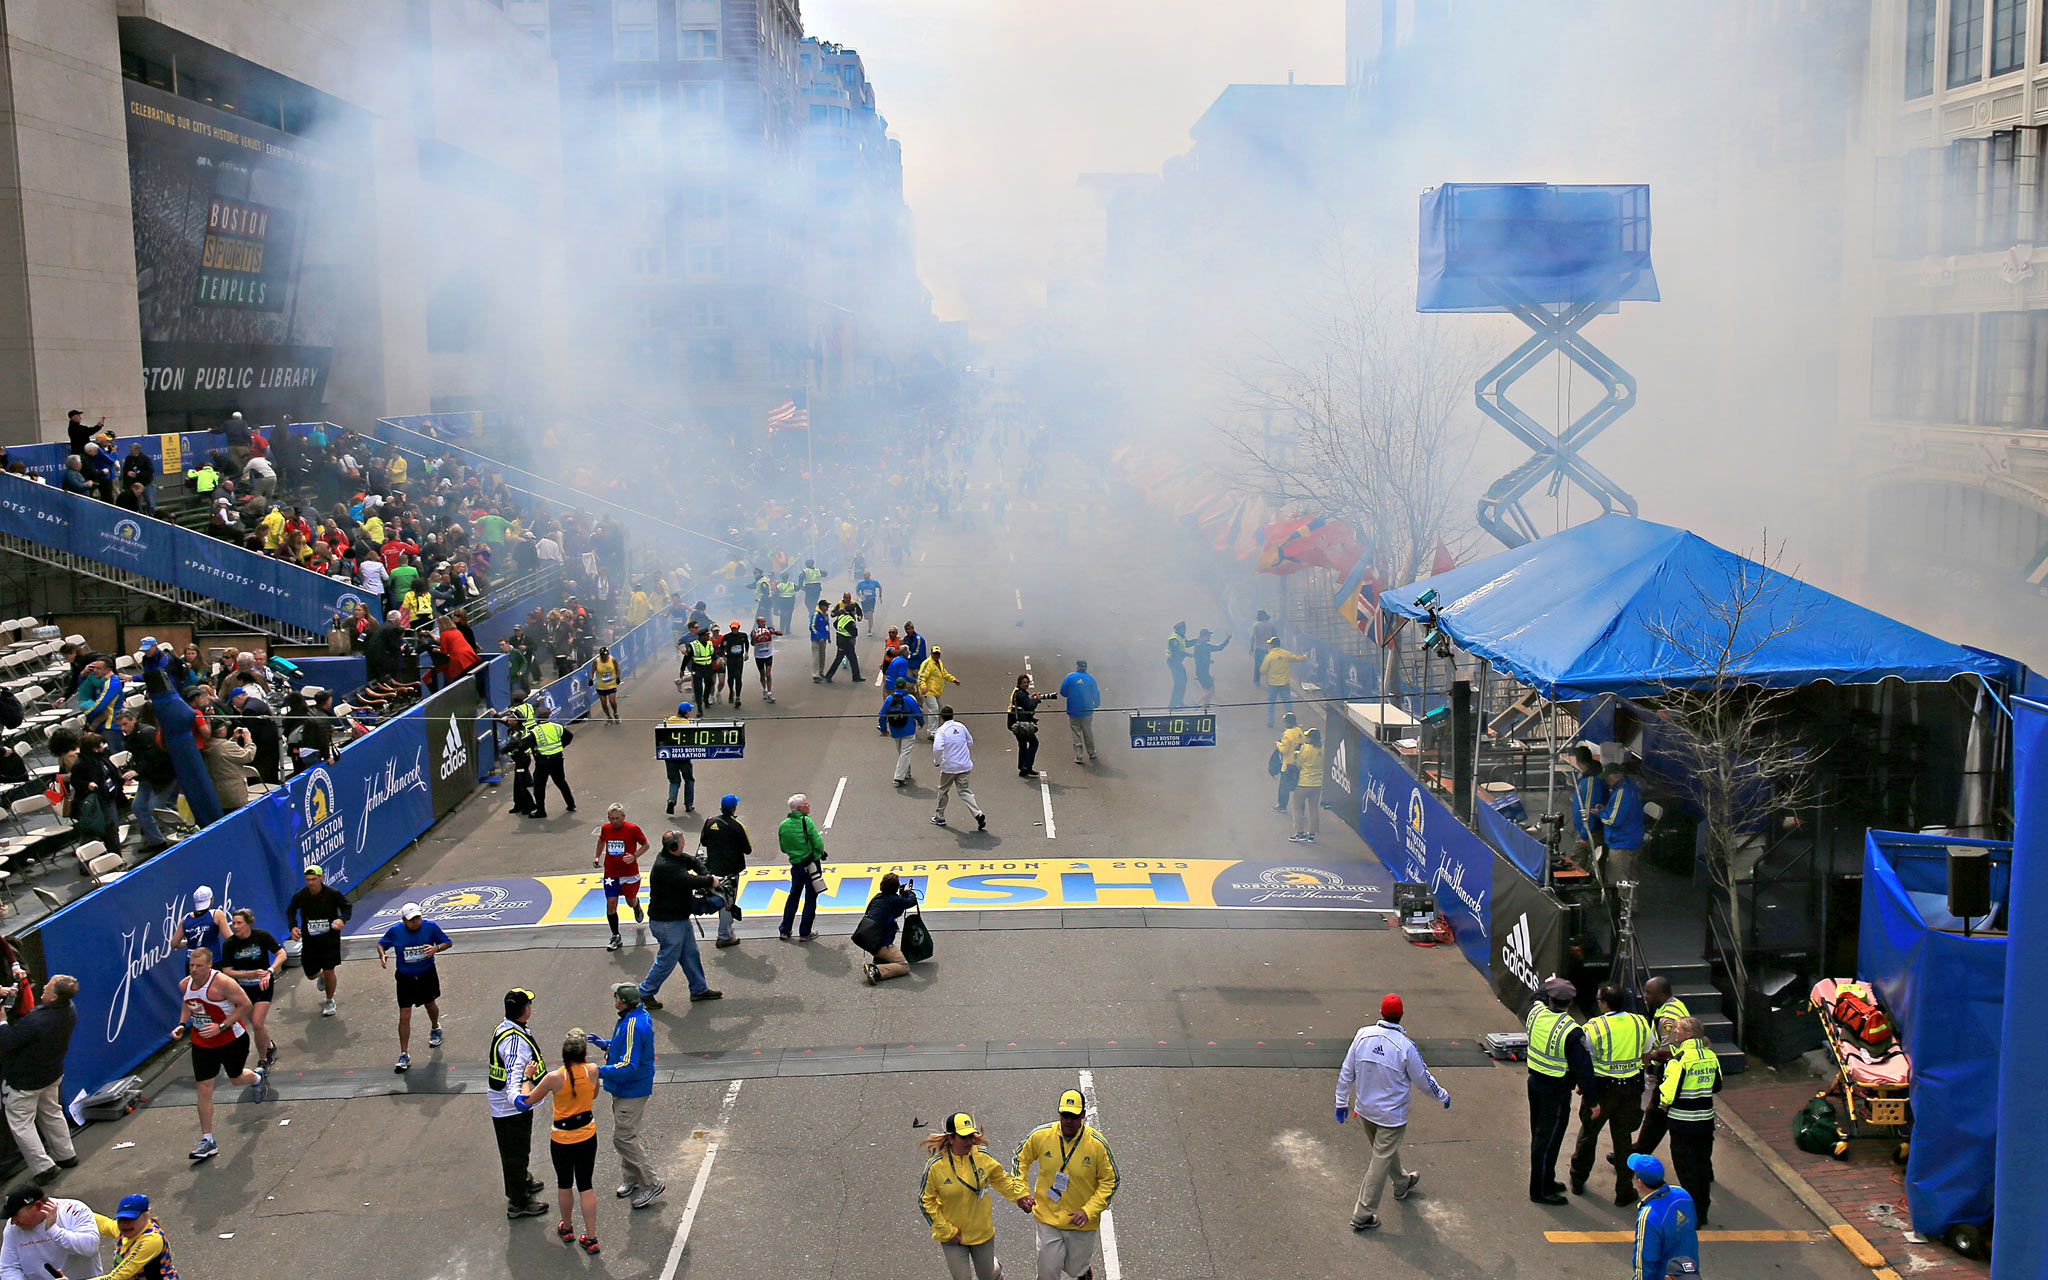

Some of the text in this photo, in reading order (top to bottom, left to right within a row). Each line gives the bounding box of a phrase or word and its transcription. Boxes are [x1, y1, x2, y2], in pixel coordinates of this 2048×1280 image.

[130, 101, 175, 126] CELEBRATING
[177, 116, 191, 131] OUR
[192, 120, 212, 137] CITY'S
[213, 127, 240, 145] HISTORIC
[210, 204, 269, 236] BOSTON
[205, 238, 262, 270] SPORTS
[200, 275, 267, 305] TEMPLES
[143, 366, 319, 391] STON PUBLIC LIBRARY
[37, 511, 63, 526] DAY
[192, 561, 284, 597] PATRIOTS' DAY
[440, 747, 467, 780] adidas
[356, 745, 428, 854] John Hancock
[315, 815, 343, 844] BOSTON
[303, 832, 346, 870] MARATHON
[866, 862, 1041, 873] MARATHON
[1112, 861, 1189, 869] 2013
[566, 872, 1190, 918] FNISH
[1231, 882, 1380, 892] BOSTON MARATHON
[1433, 845, 1487, 938] John Hancock
[441, 900, 530, 913] MARATHON
[106, 921, 164, 1043] John
[1502, 946, 1540, 992] adidas
[1688, 1066, 1717, 1076] Boston
